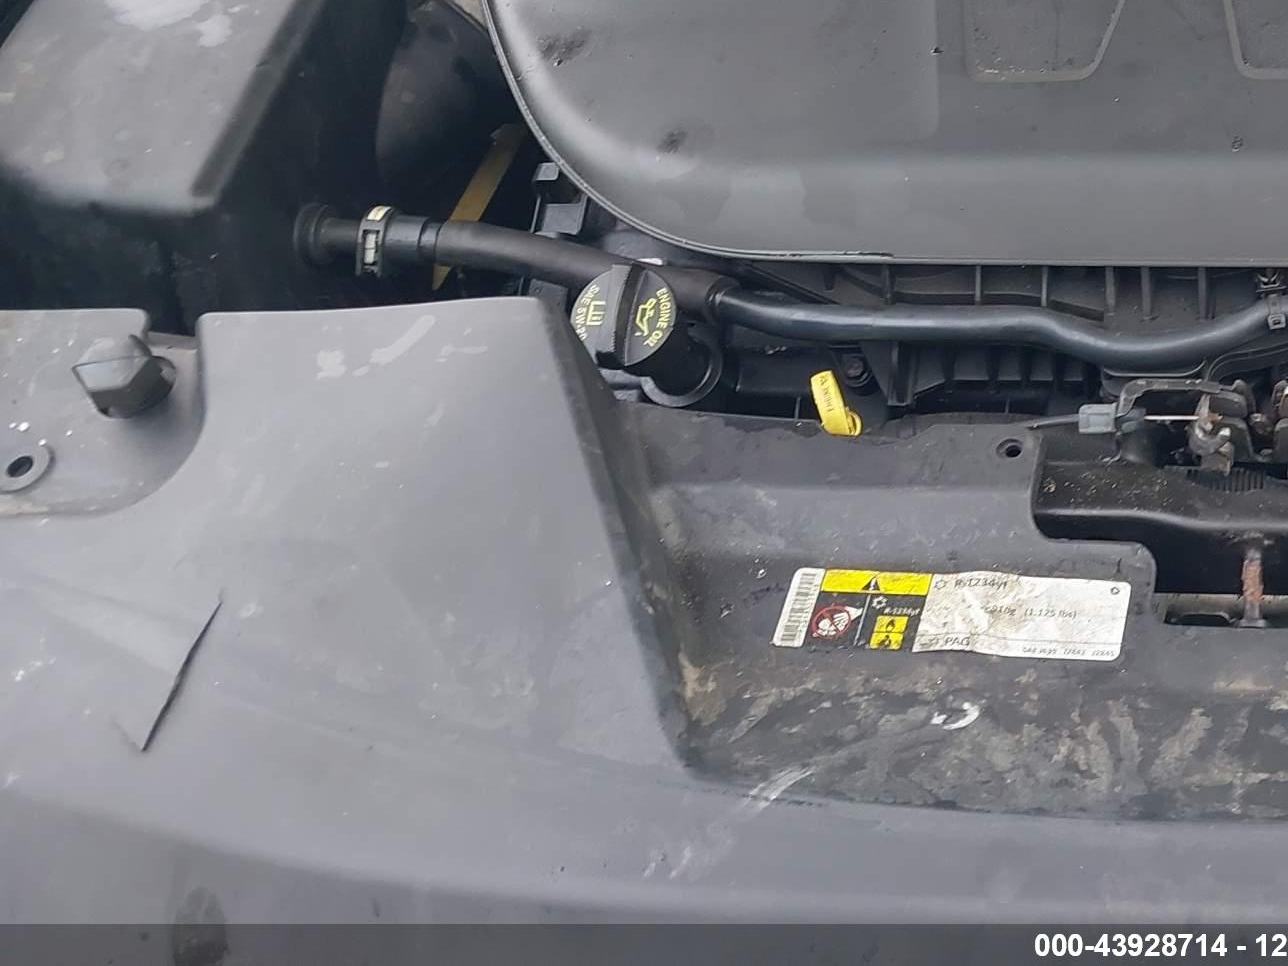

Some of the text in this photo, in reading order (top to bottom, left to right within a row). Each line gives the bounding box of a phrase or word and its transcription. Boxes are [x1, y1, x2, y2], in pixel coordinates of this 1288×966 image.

[580, 284, 600, 305] SAE
[643, 287, 672, 347] ENGINE OIL
[944, 637, 971, 647] PAG
